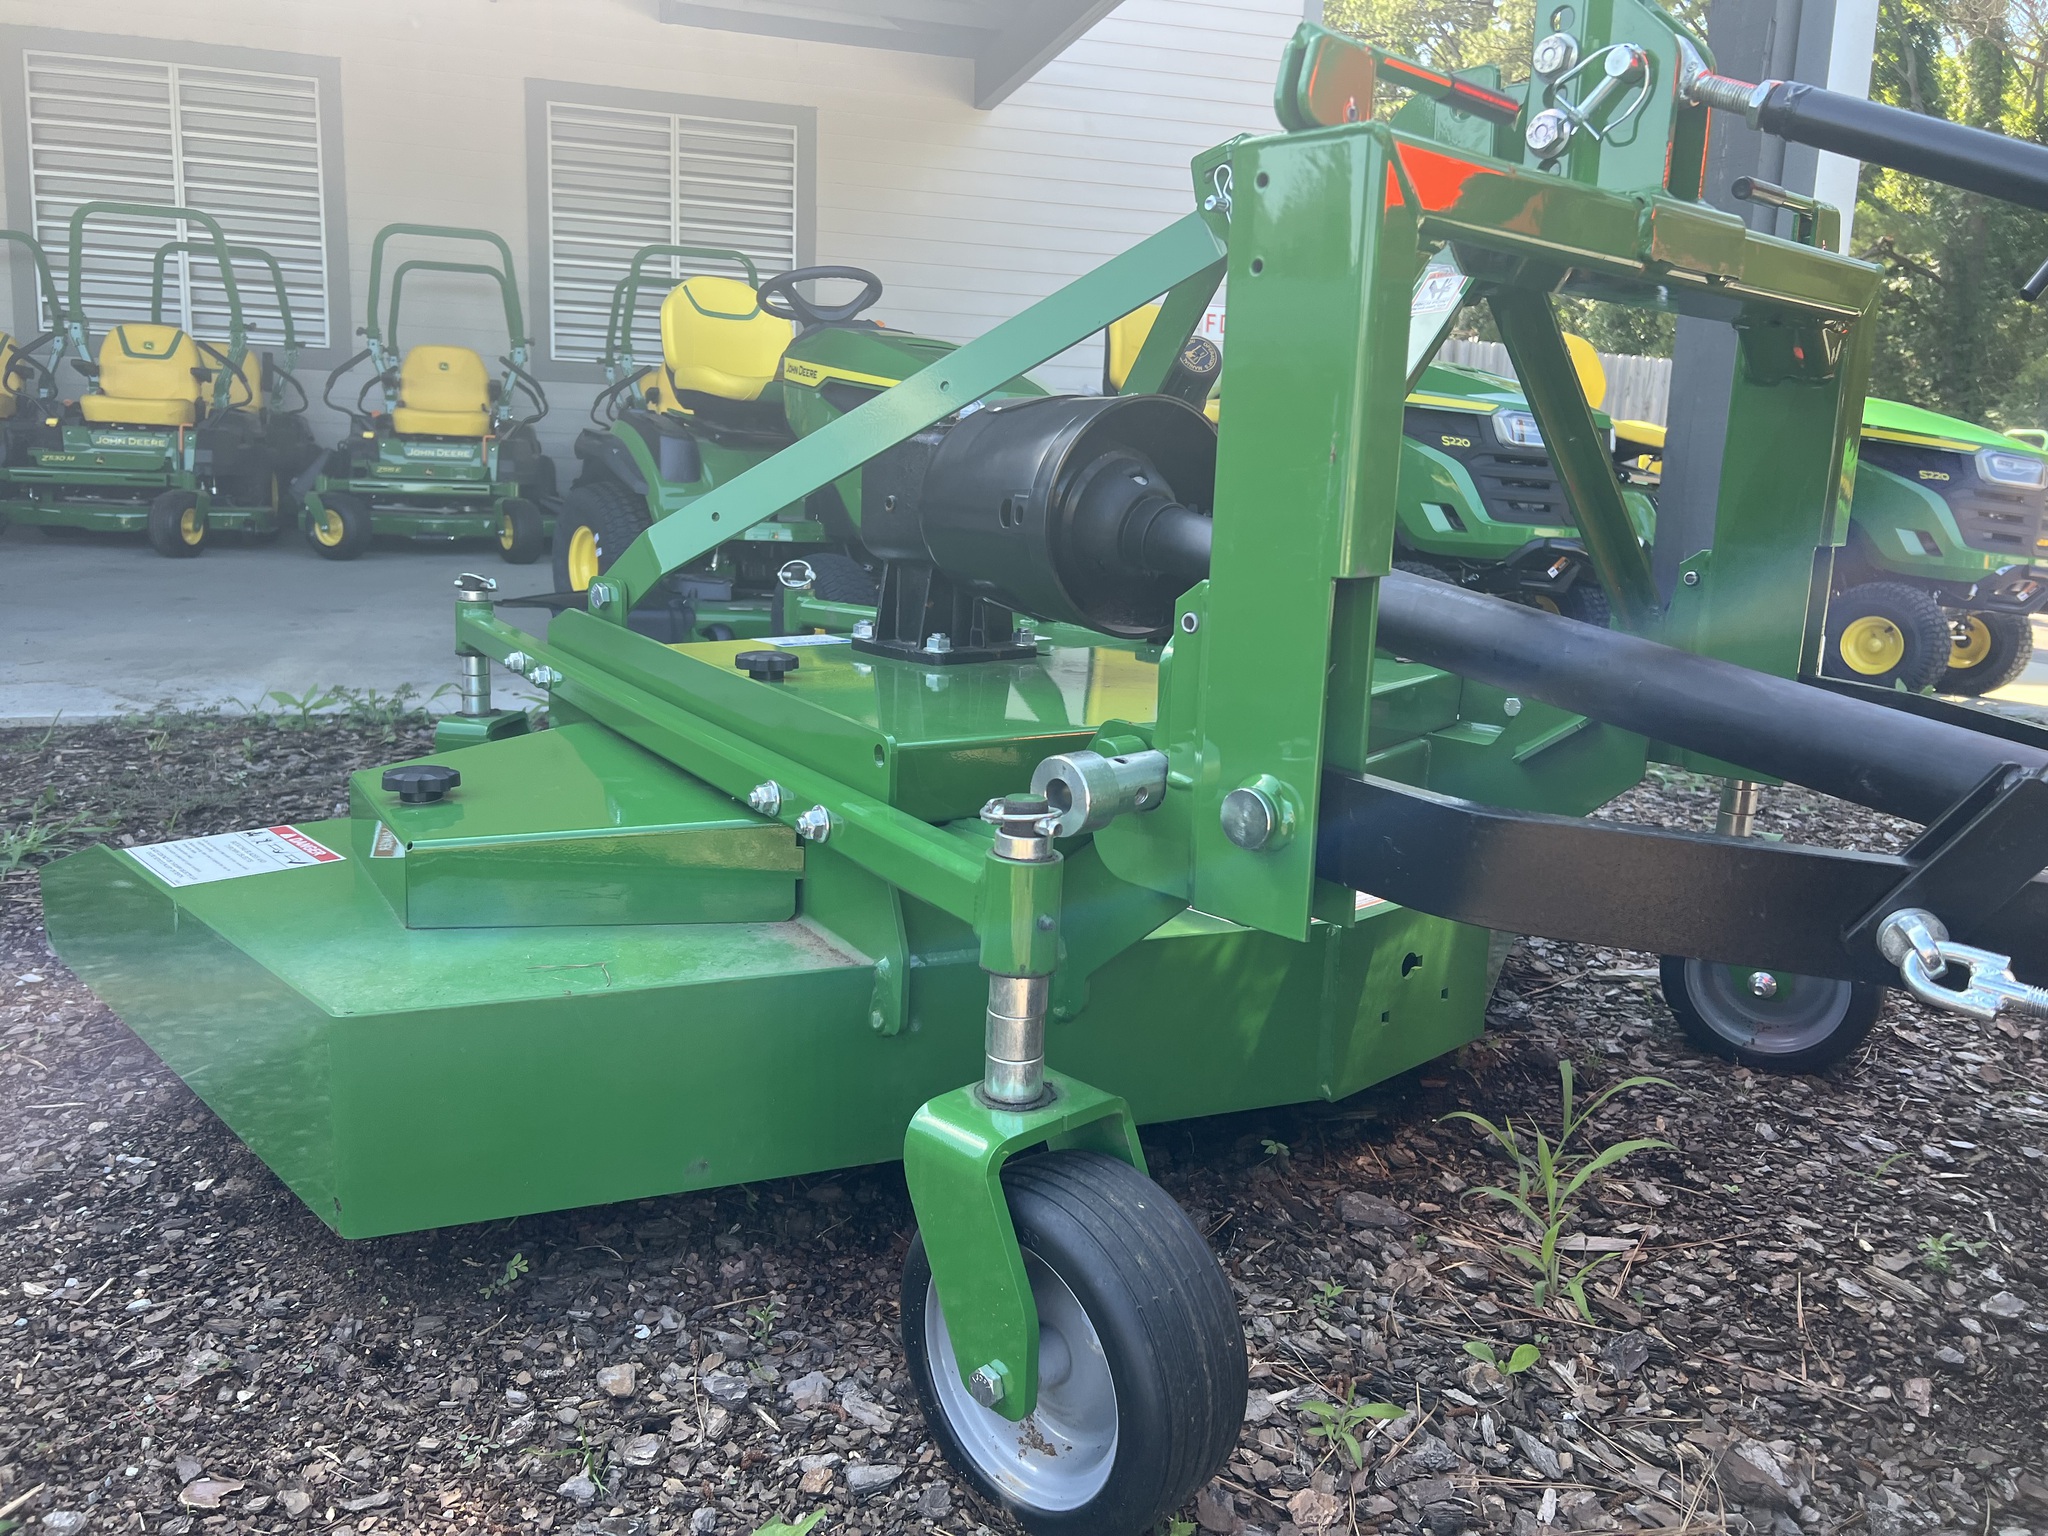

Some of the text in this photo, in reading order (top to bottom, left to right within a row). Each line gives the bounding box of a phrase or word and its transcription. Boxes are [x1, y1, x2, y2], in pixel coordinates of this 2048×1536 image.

[786, 363, 818, 379] JOHN DEERE
[95, 436, 166, 447] JOHN DEERE
[1441, 435, 1471, 448] S220
[407, 447, 471, 458] JOHN DEERE
[1919, 470, 1950, 481] S220
[289, 837, 327, 856] DANGER
